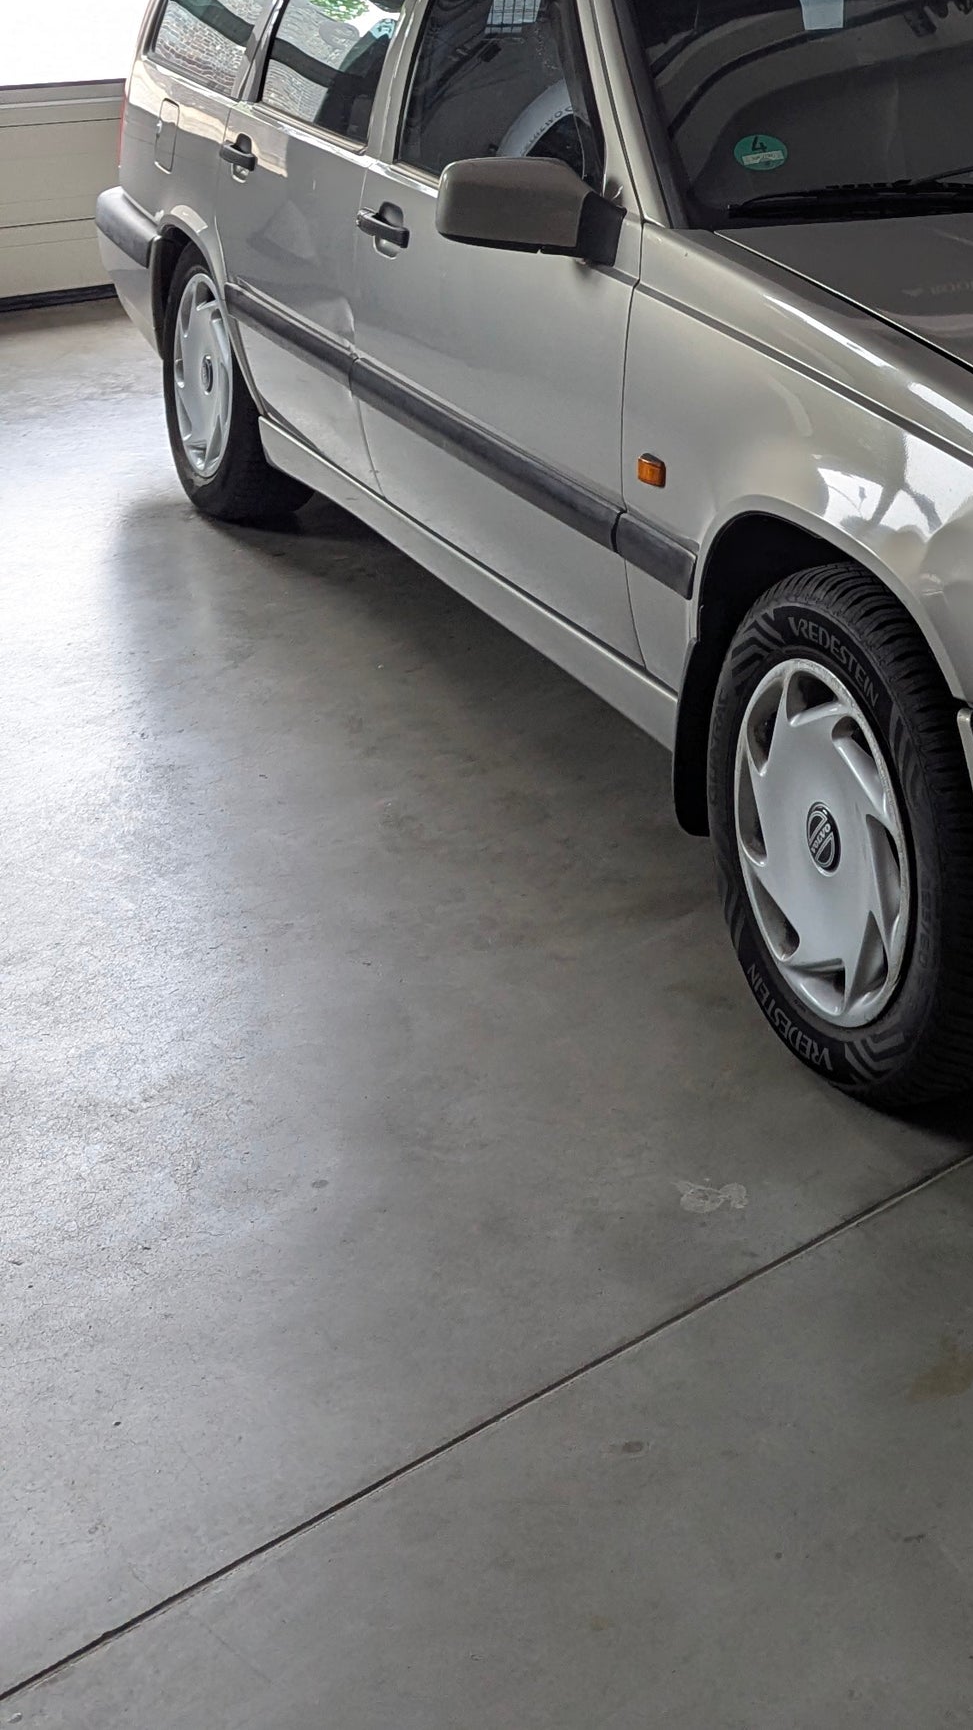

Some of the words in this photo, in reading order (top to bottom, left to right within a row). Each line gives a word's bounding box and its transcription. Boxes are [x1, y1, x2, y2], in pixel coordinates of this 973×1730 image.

[751, 135, 768, 152] 4
[787, 616, 879, 707] VREDESTEIN
[811, 822, 831, 853] VOLVO
[747, 963, 833, 1071] VREDESTEIN
